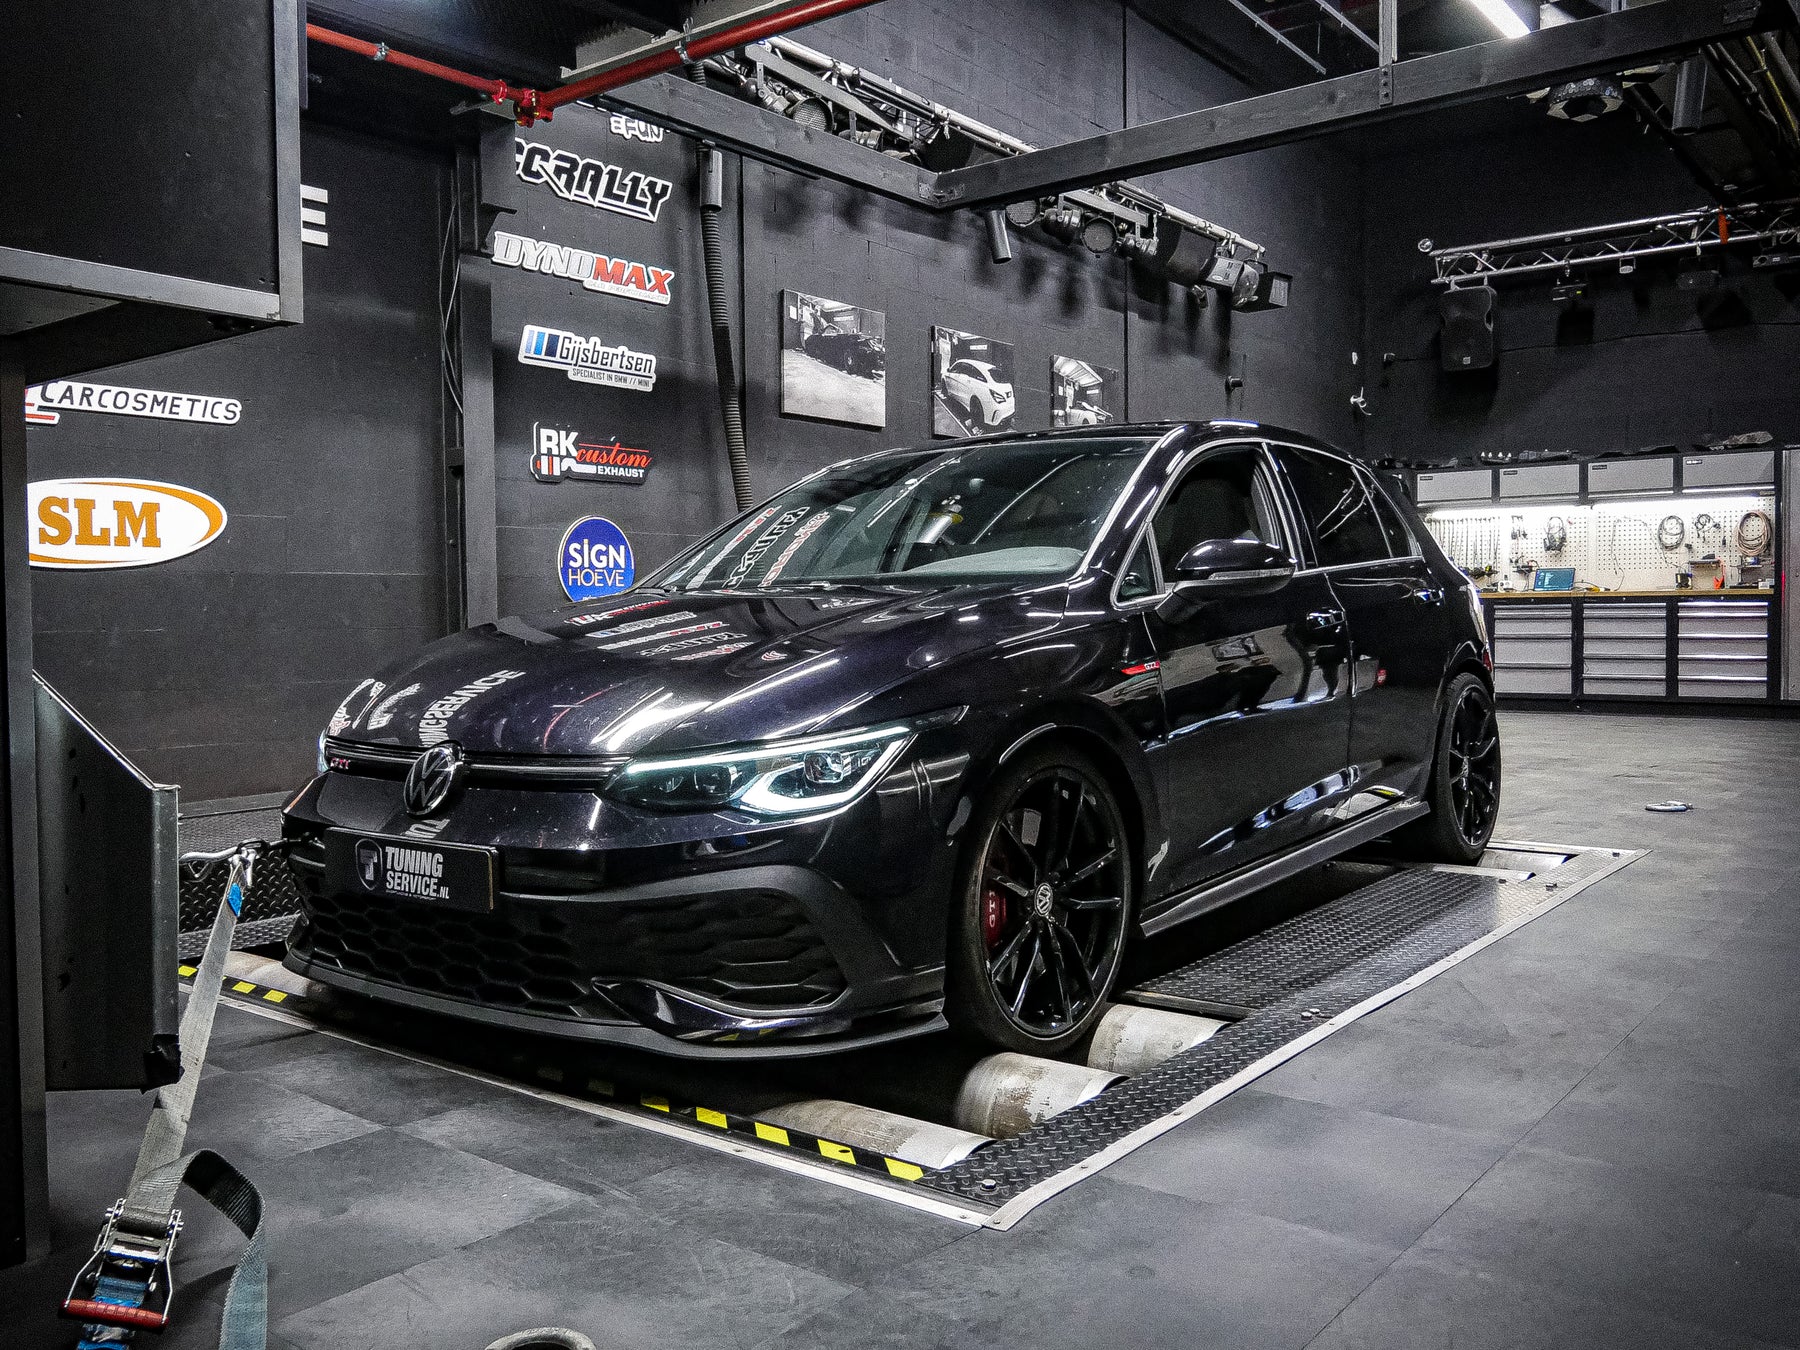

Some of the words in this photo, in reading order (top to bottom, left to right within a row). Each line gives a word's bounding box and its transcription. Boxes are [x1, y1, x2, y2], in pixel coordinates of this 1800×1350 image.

[495, 232, 673, 296] DYNOMAX
[560, 335, 653, 374] Gijsbertsen
[572, 368, 606, 380] SPECIALIST
[40, 381, 239, 420] CARCOSMETICS
[540, 428, 578, 457] RK
[576, 442, 652, 468] custom
[598, 466, 645, 478] EXHAUST
[38, 496, 161, 548] SLM
[568, 568, 625, 587] HOEVE
[330, 757, 350, 769] GTI
[386, 846, 443, 877] TUNING
[386, 871, 450, 899] SERVICE.NL
